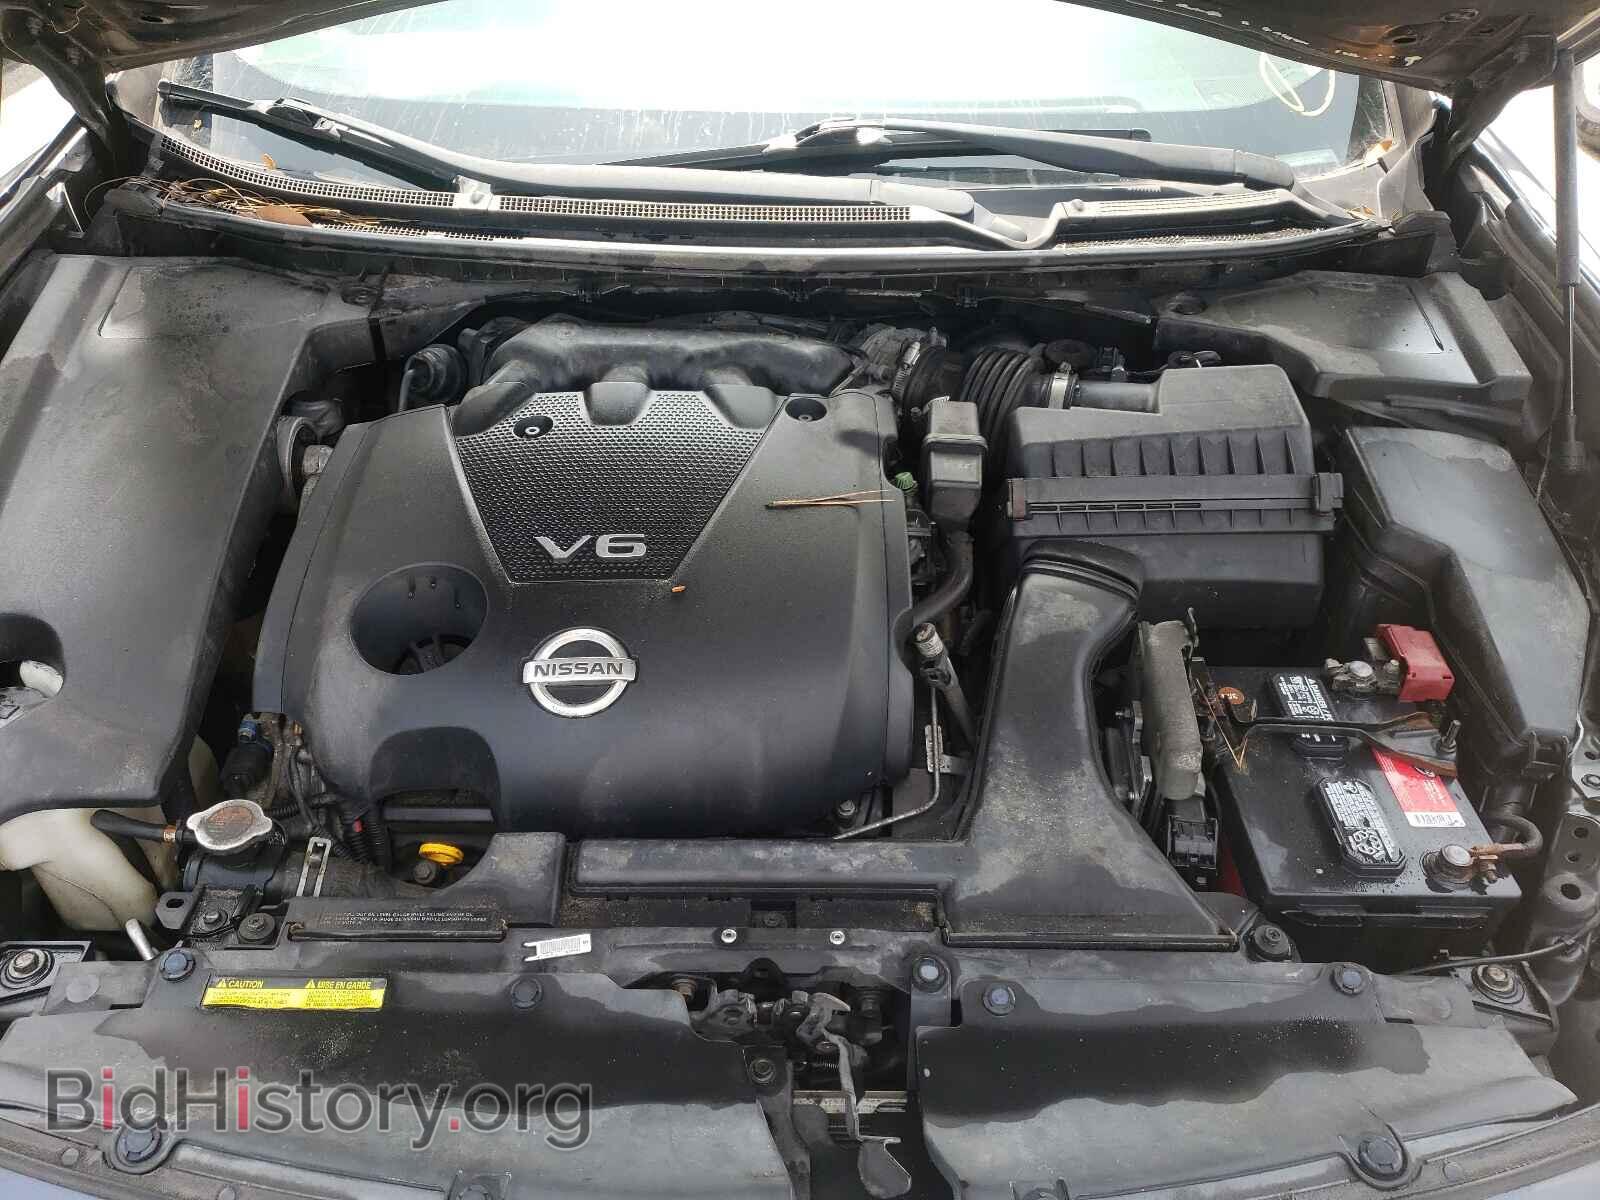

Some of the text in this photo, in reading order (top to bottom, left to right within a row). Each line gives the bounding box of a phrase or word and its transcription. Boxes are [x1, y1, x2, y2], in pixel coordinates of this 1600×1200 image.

[533, 534, 647, 559] V6
[534, 662, 624, 678] NISSAN
[228, 980, 264, 989] CAUTION
